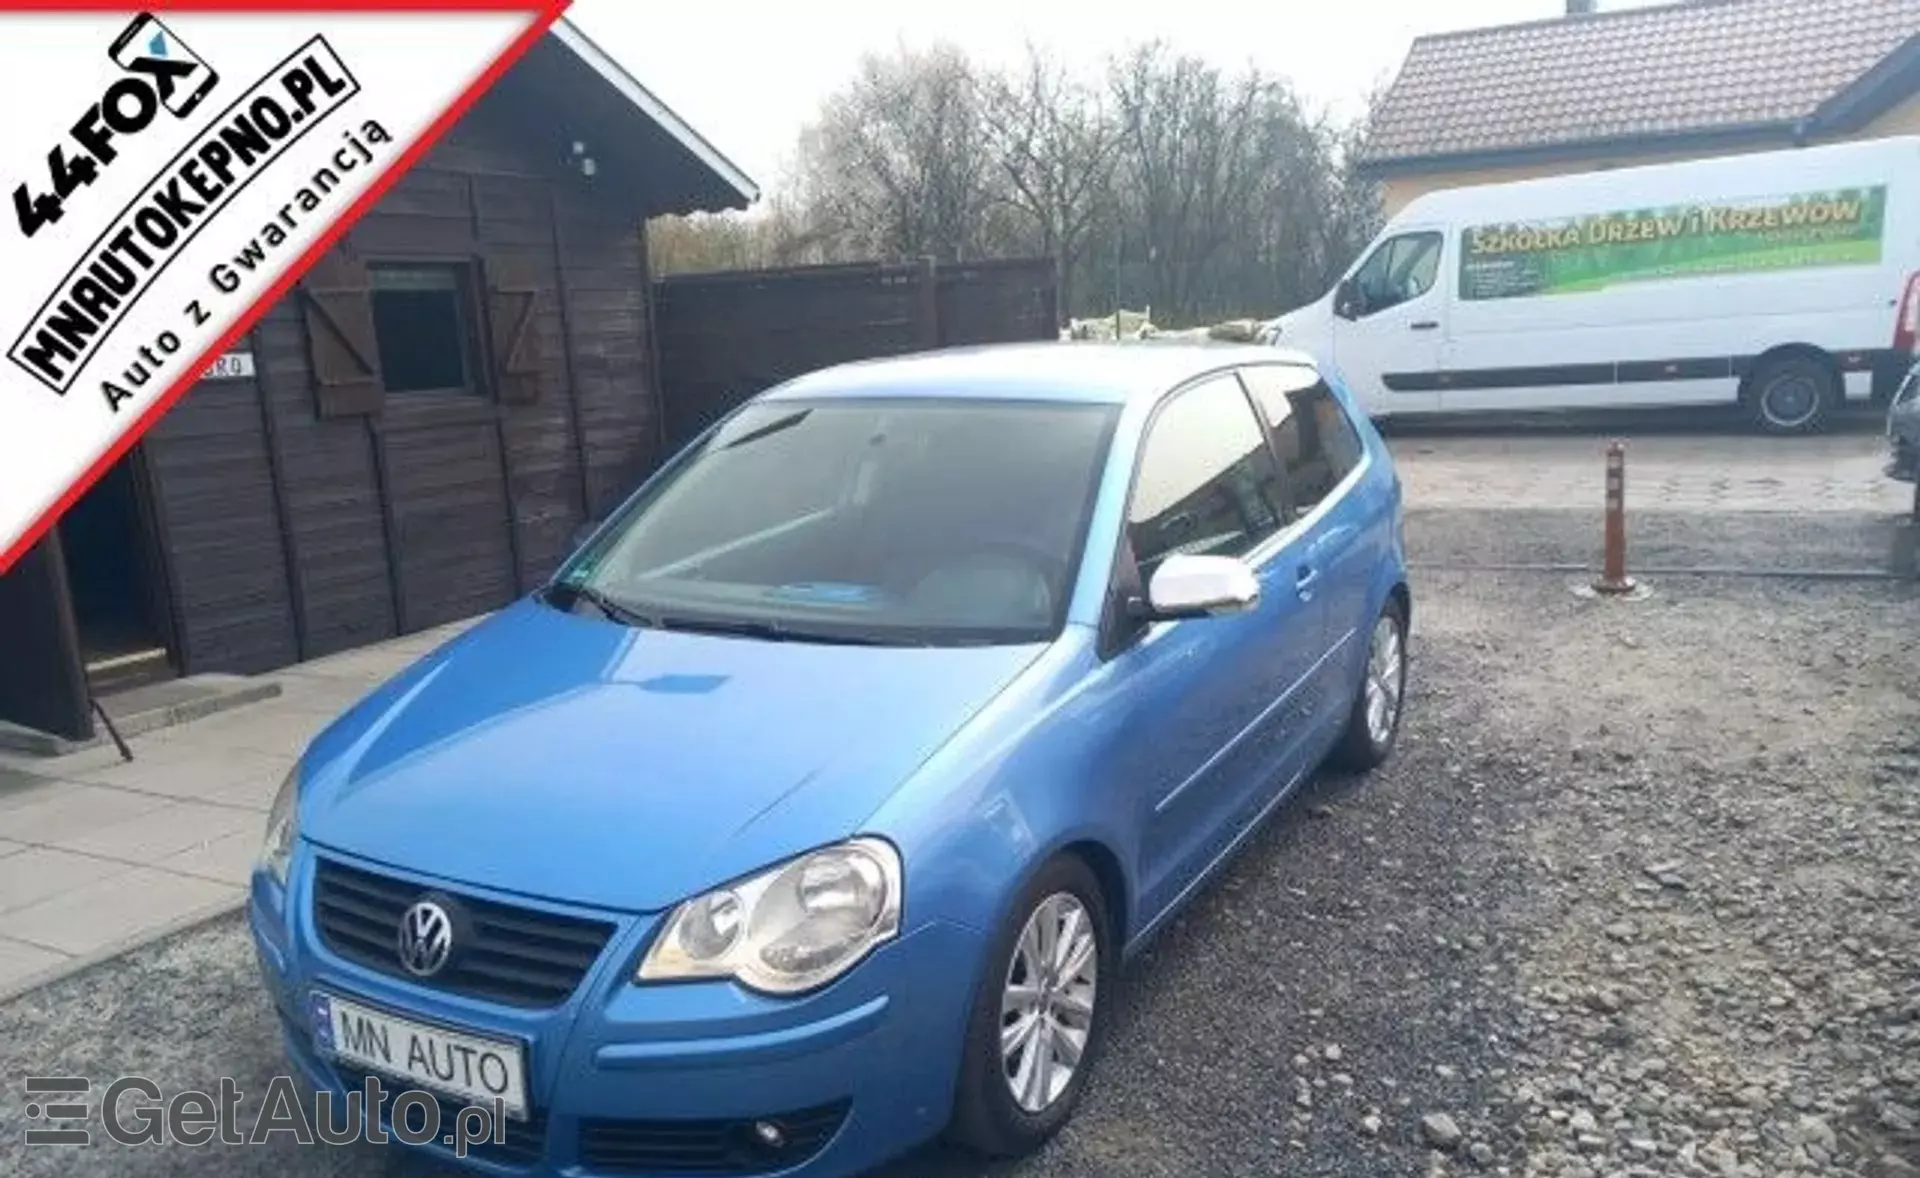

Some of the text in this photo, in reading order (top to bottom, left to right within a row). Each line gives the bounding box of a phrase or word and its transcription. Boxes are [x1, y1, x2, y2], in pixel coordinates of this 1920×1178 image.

[1589, 215, 1683, 245] DRZEW
[341, 1011, 509, 1094] MN AUTO
